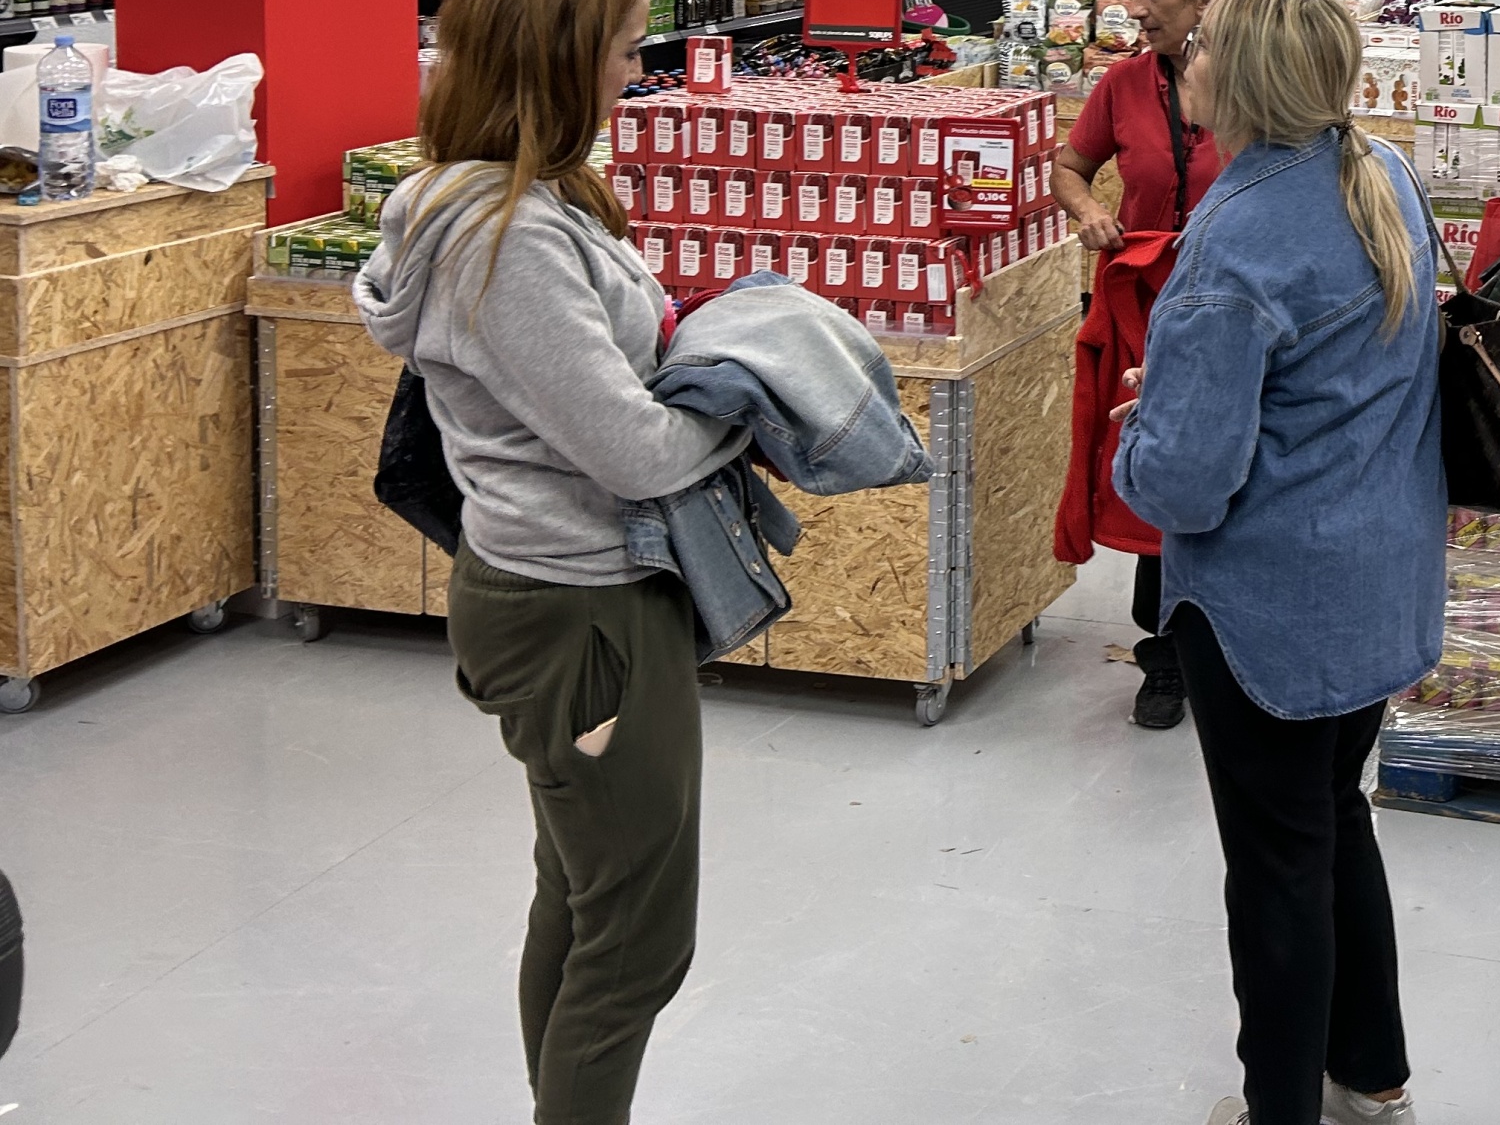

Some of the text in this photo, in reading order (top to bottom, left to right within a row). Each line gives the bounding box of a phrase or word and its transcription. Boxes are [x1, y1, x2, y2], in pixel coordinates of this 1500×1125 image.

[1440, 12, 1463, 24] Río
[1434, 105, 1457, 118] Río
[977, 192, 1008, 202] 0,10€
